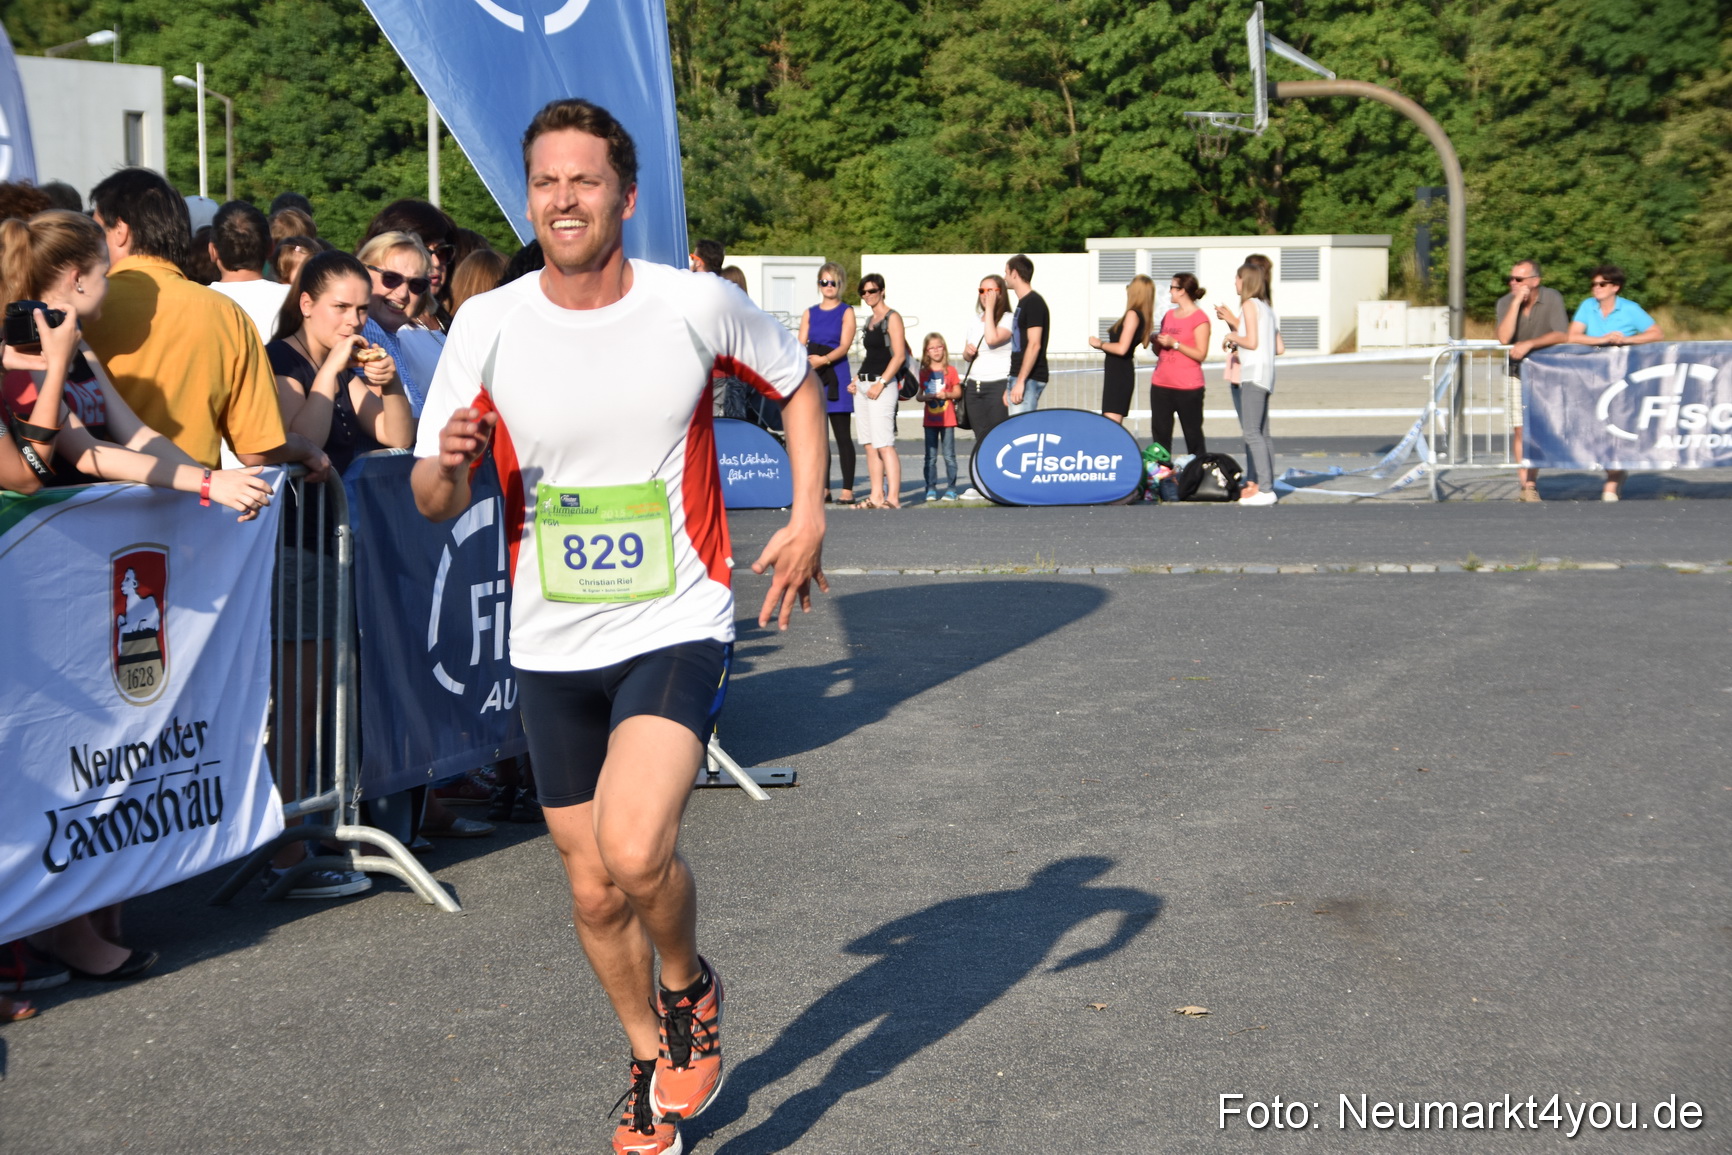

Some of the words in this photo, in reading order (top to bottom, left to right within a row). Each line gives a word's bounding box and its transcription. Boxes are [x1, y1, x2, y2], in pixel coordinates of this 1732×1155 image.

[22, 445, 47, 475] SONY
[719, 453, 739, 466] das
[1020, 450, 1123, 473] Fischer
[727, 468, 755, 485] fährt
[758, 467, 780, 480] mit!
[1031, 472, 1117, 484] AUTOMOBILE
[563, 532, 644, 570] 829
[578, 578, 616, 586] Christian
[616, 577, 633, 585] Riel
[470, 581, 512, 666] Fi
[127, 665, 155, 690] 1628
[69, 716, 208, 792] Neumrkter
